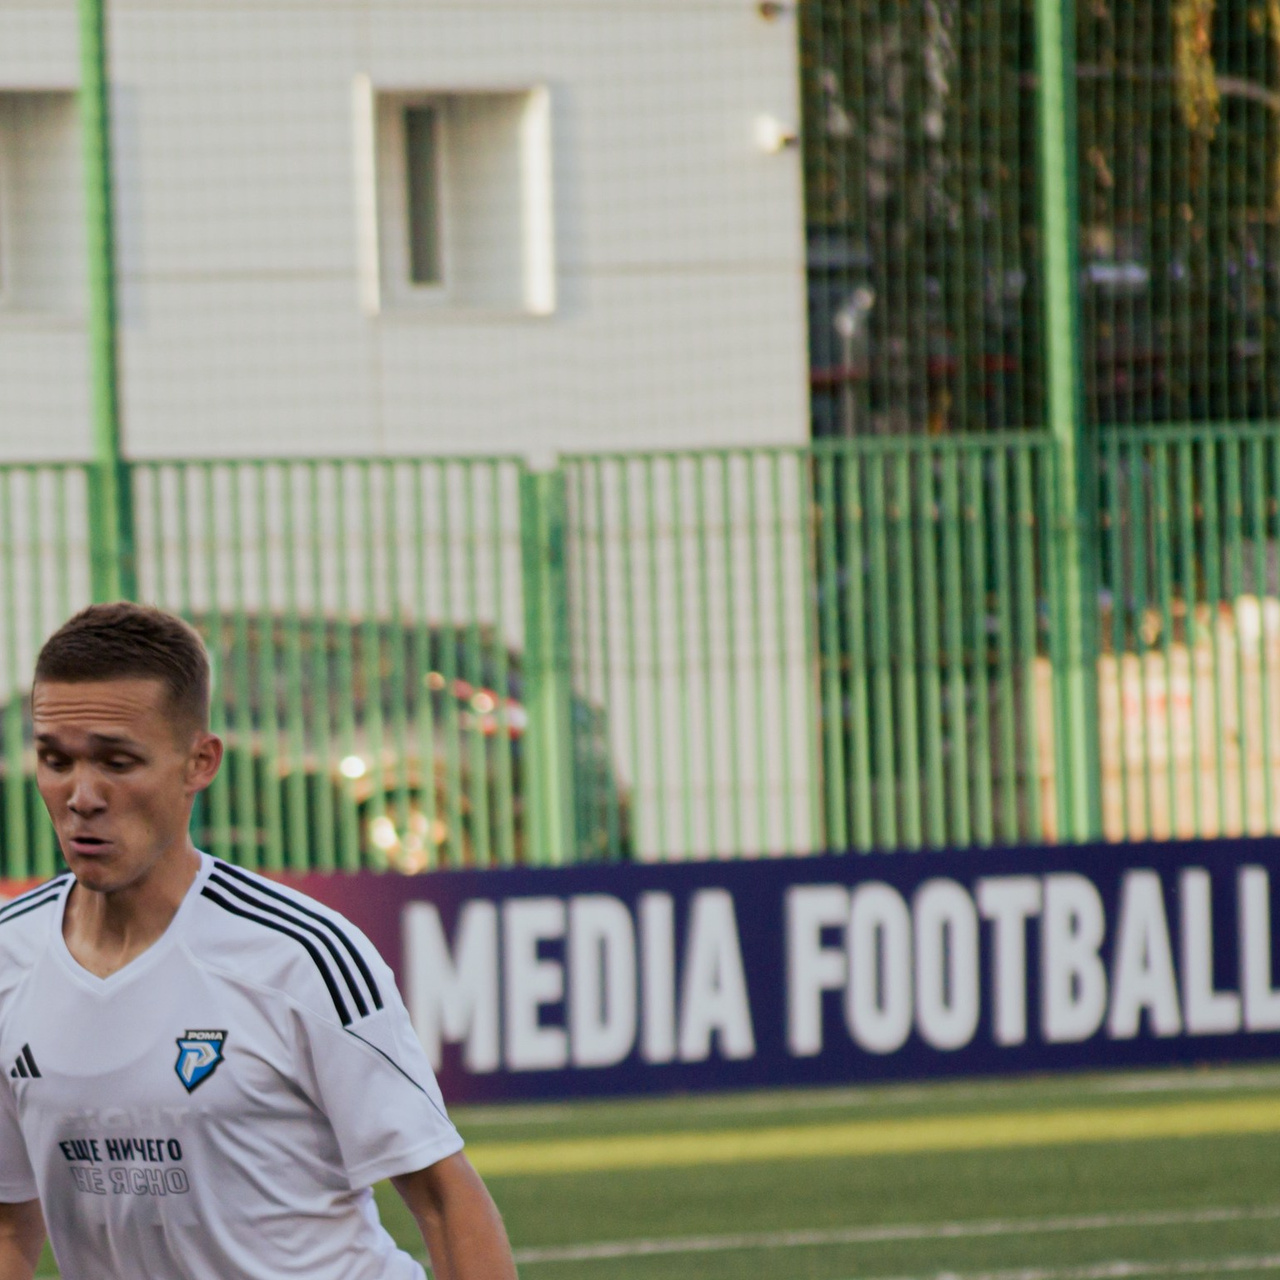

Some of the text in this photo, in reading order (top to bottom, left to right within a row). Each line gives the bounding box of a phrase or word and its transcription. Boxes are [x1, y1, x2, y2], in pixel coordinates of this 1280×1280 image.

[401, 863, 1280, 1074] MEDIA FOOTBALL
[58, 1138, 183, 1165] ЕЩЕ НИЧЕГО
[70, 1166, 190, 1197] НЕ ЯСНО
